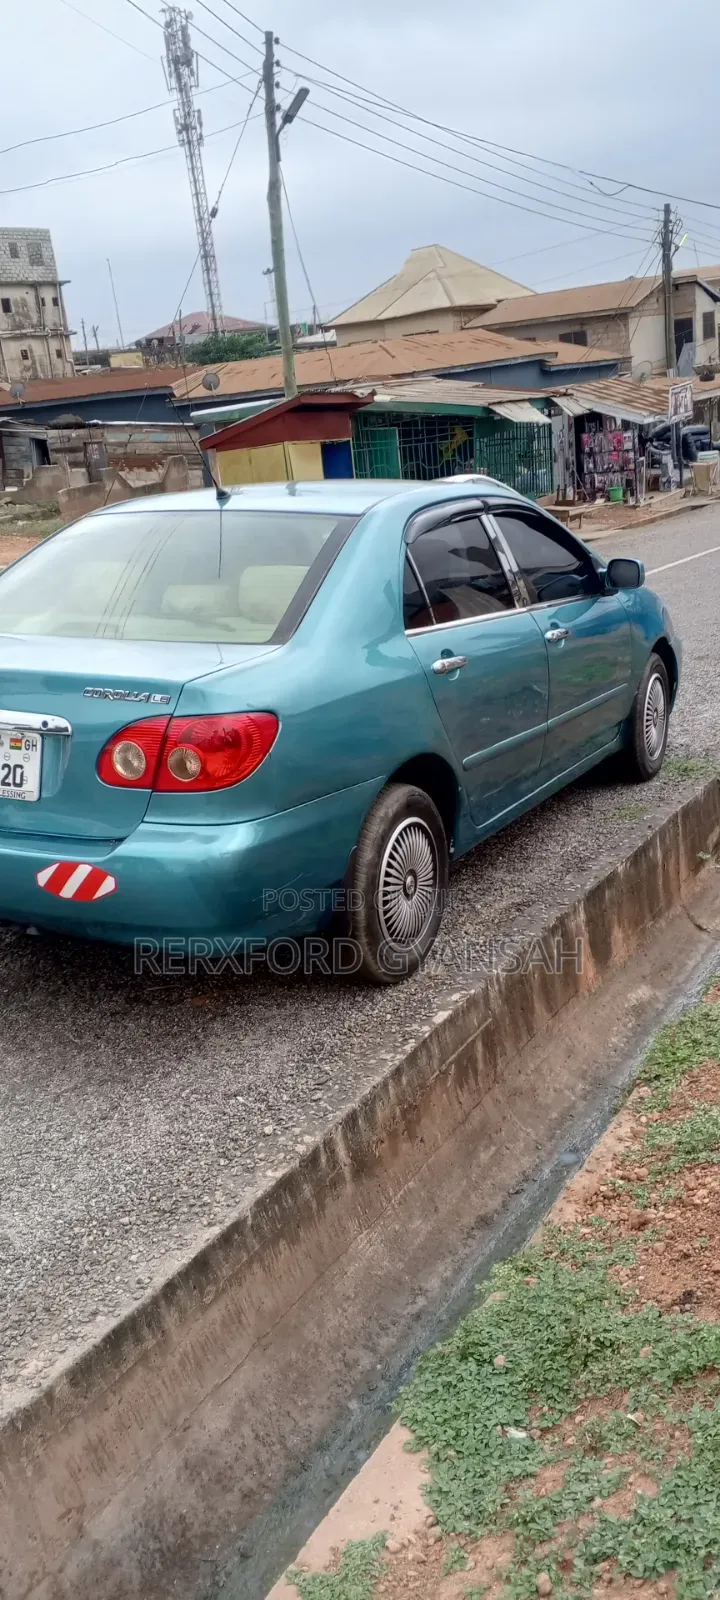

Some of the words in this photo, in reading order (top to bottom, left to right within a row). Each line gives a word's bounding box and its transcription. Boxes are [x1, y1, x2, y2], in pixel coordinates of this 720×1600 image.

[151, 693, 171, 704] LE
[24, 739, 38, 752] GH
[0, 763, 25, 788] 20
[0, 789, 26, 800] ESSING
